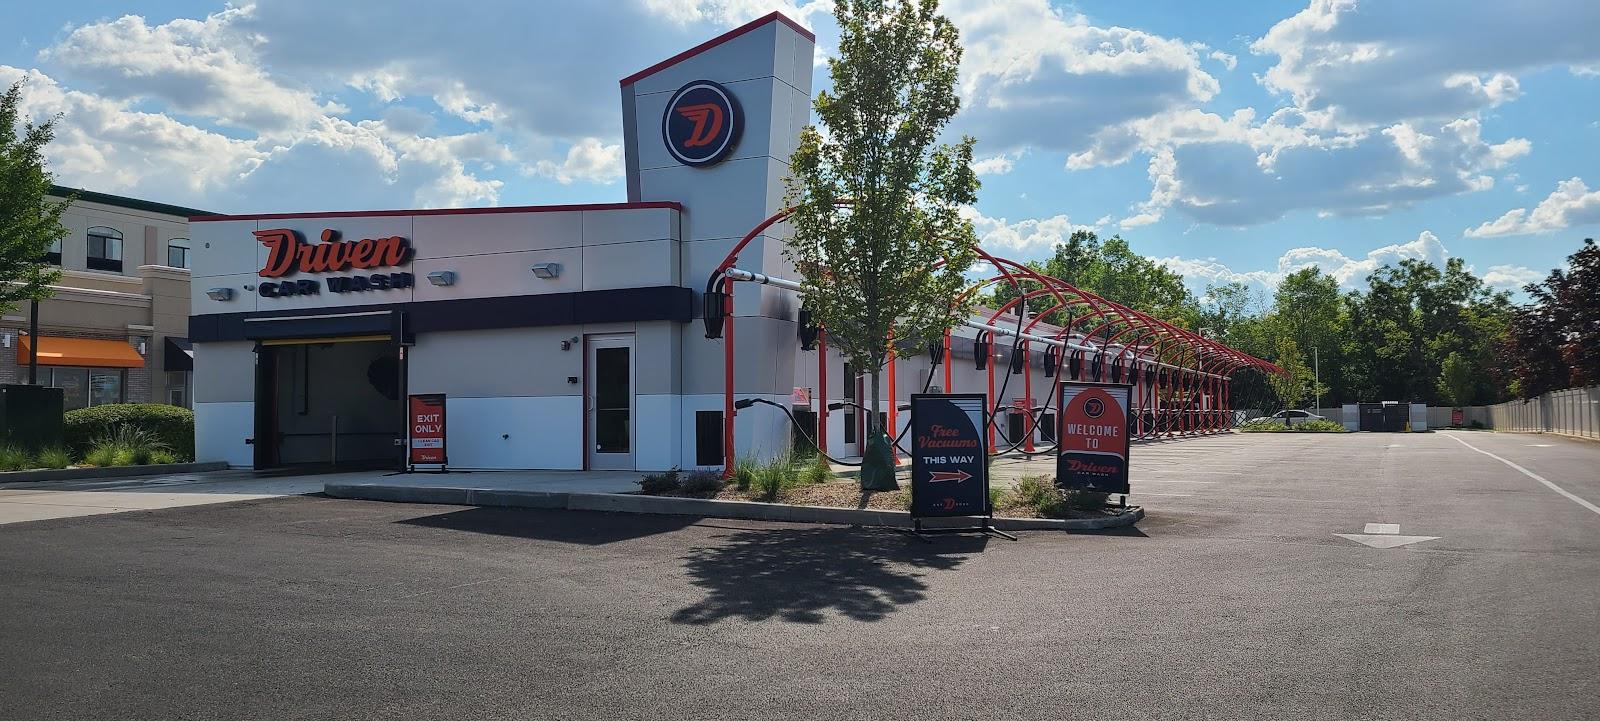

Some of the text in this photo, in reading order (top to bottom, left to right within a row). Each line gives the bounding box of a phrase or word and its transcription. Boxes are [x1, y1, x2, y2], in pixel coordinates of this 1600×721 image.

[252, 228, 408, 278] Driven
[258, 272, 415, 298] CAR WASH
[417, 414, 440, 423] EXIT
[415, 424, 442, 433] ONLY
[931, 424, 960, 437] Free
[1067, 424, 1118, 436] WELCOME
[918, 436, 977, 448] Vacuums
[1086, 438, 1099, 449] TO
[922, 455, 975, 464] THIS WAY
[1066, 459, 1119, 473] Driven
